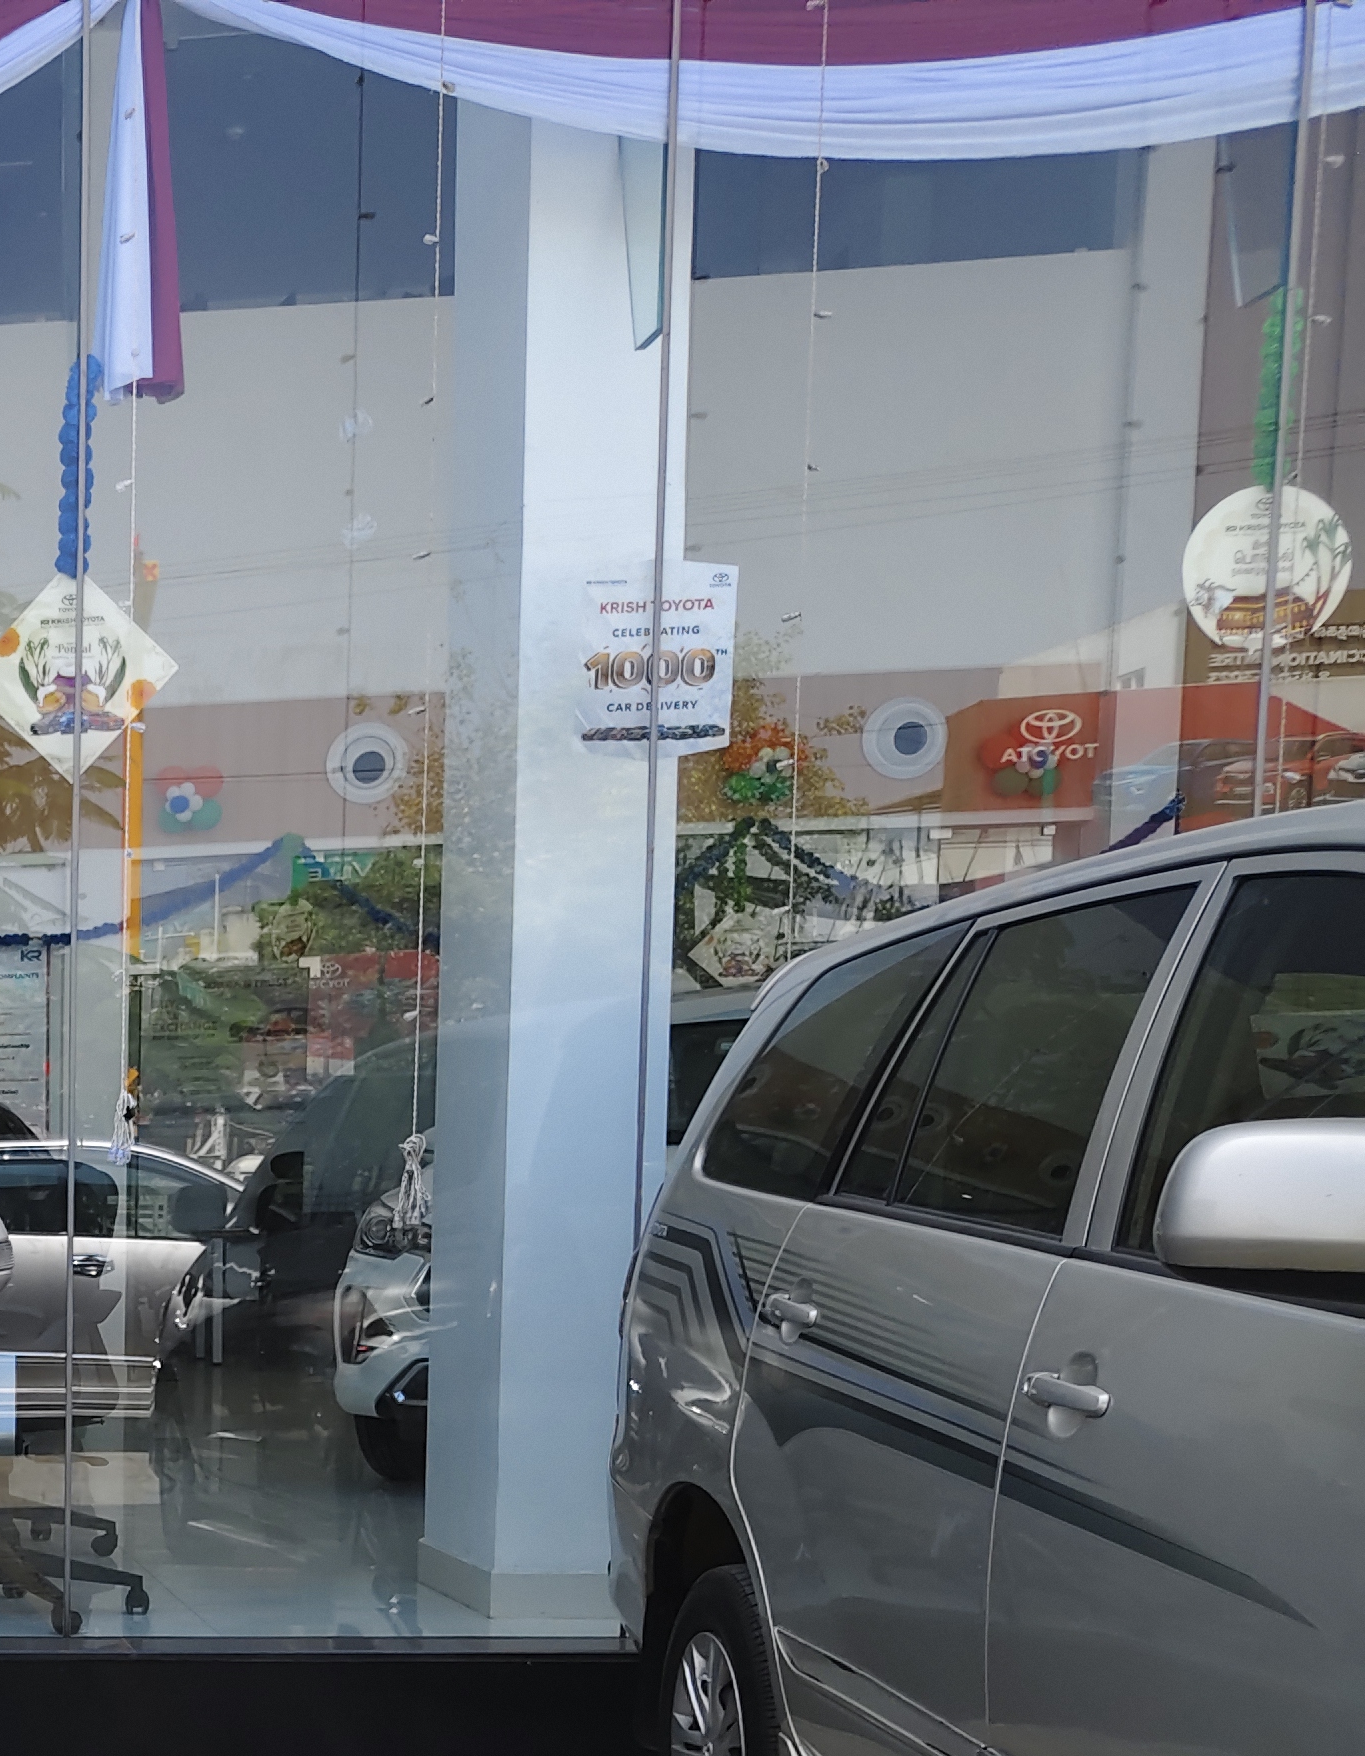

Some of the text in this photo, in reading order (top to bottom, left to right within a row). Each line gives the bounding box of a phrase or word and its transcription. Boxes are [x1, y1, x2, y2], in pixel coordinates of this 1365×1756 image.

[599, 598, 715, 615] KRISH OYOTA
[612, 625, 701, 638] CELEBATING
[56, 643, 92, 654] Ponal
[606, 700, 699, 713] CAR DEIVERY
